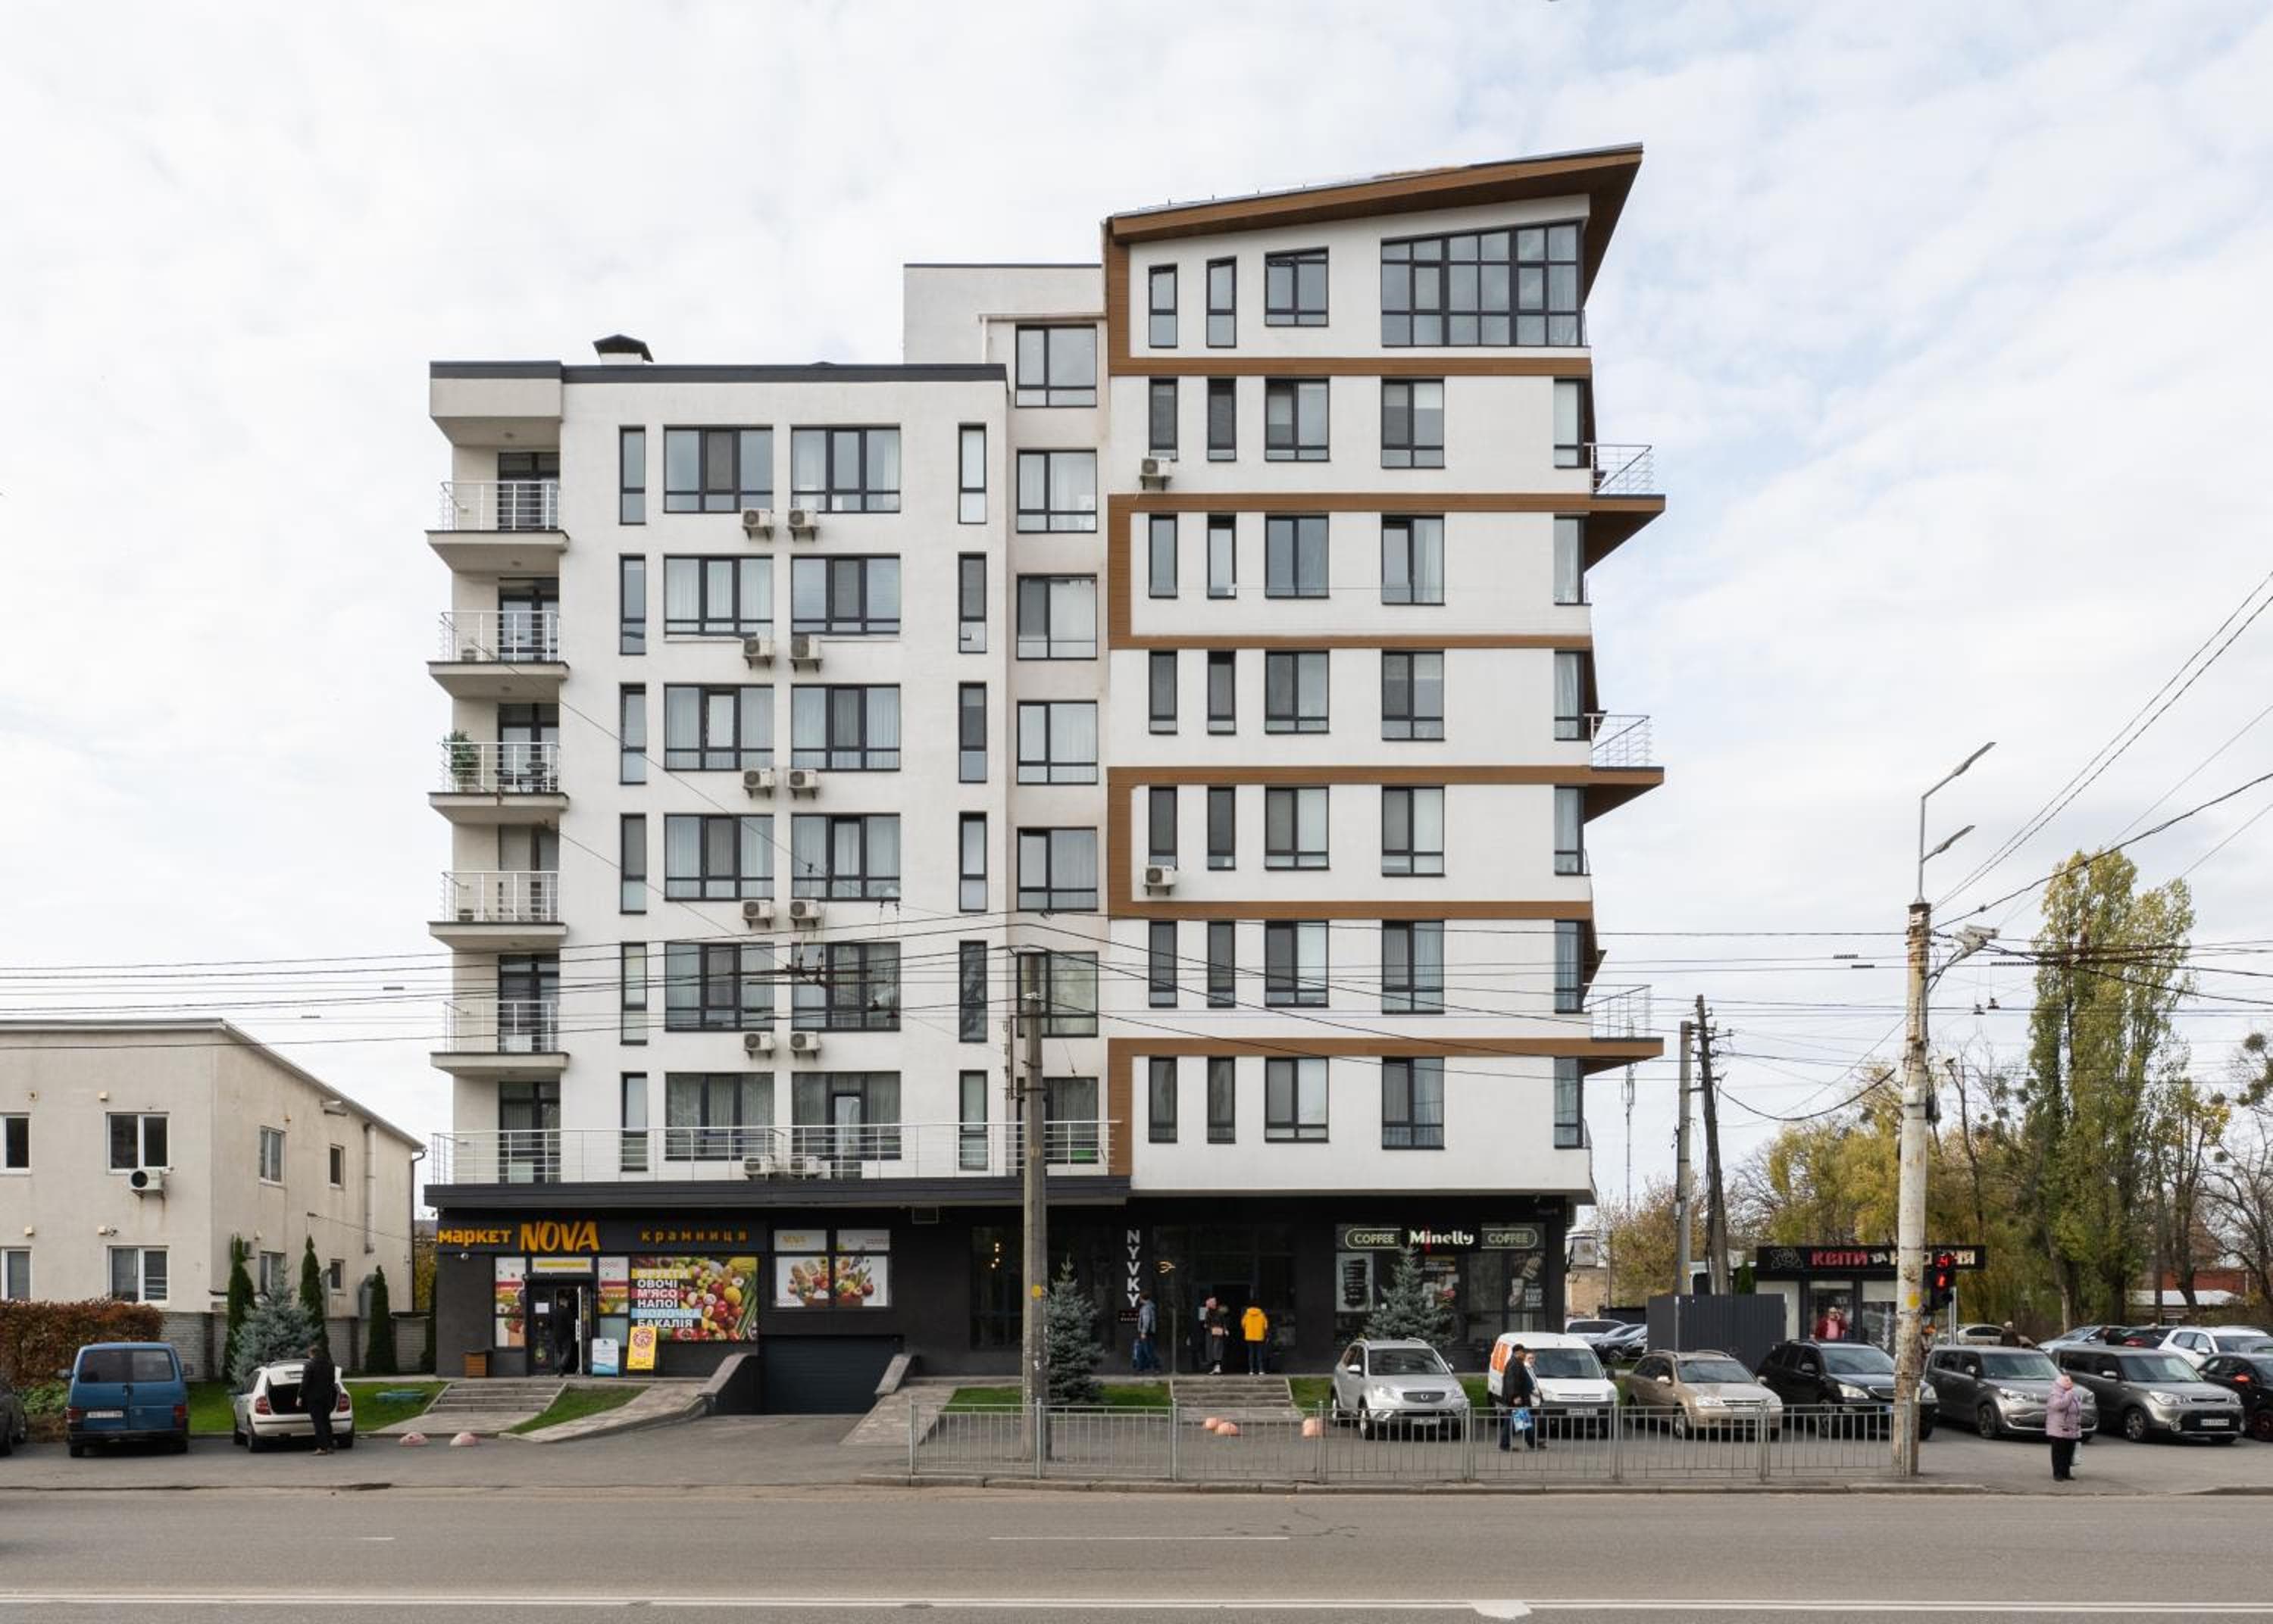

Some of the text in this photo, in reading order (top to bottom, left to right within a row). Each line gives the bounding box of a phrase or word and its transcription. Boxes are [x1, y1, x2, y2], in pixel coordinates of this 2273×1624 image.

[438, 1229, 511, 1247] маркет
[520, 1221, 600, 1251] NOVA
[642, 1229, 749, 1245] крамниця
[1354, 1229, 1529, 1245] COFFEE Minelly COFFEE
[1127, 1229, 1140, 1307] NYVKY
[636, 1279, 678, 1288] ОВОЧІ
[636, 1288, 678, 1298] М'ЯСО
[636, 1319, 693, 1328] БАКАЛІЯ
